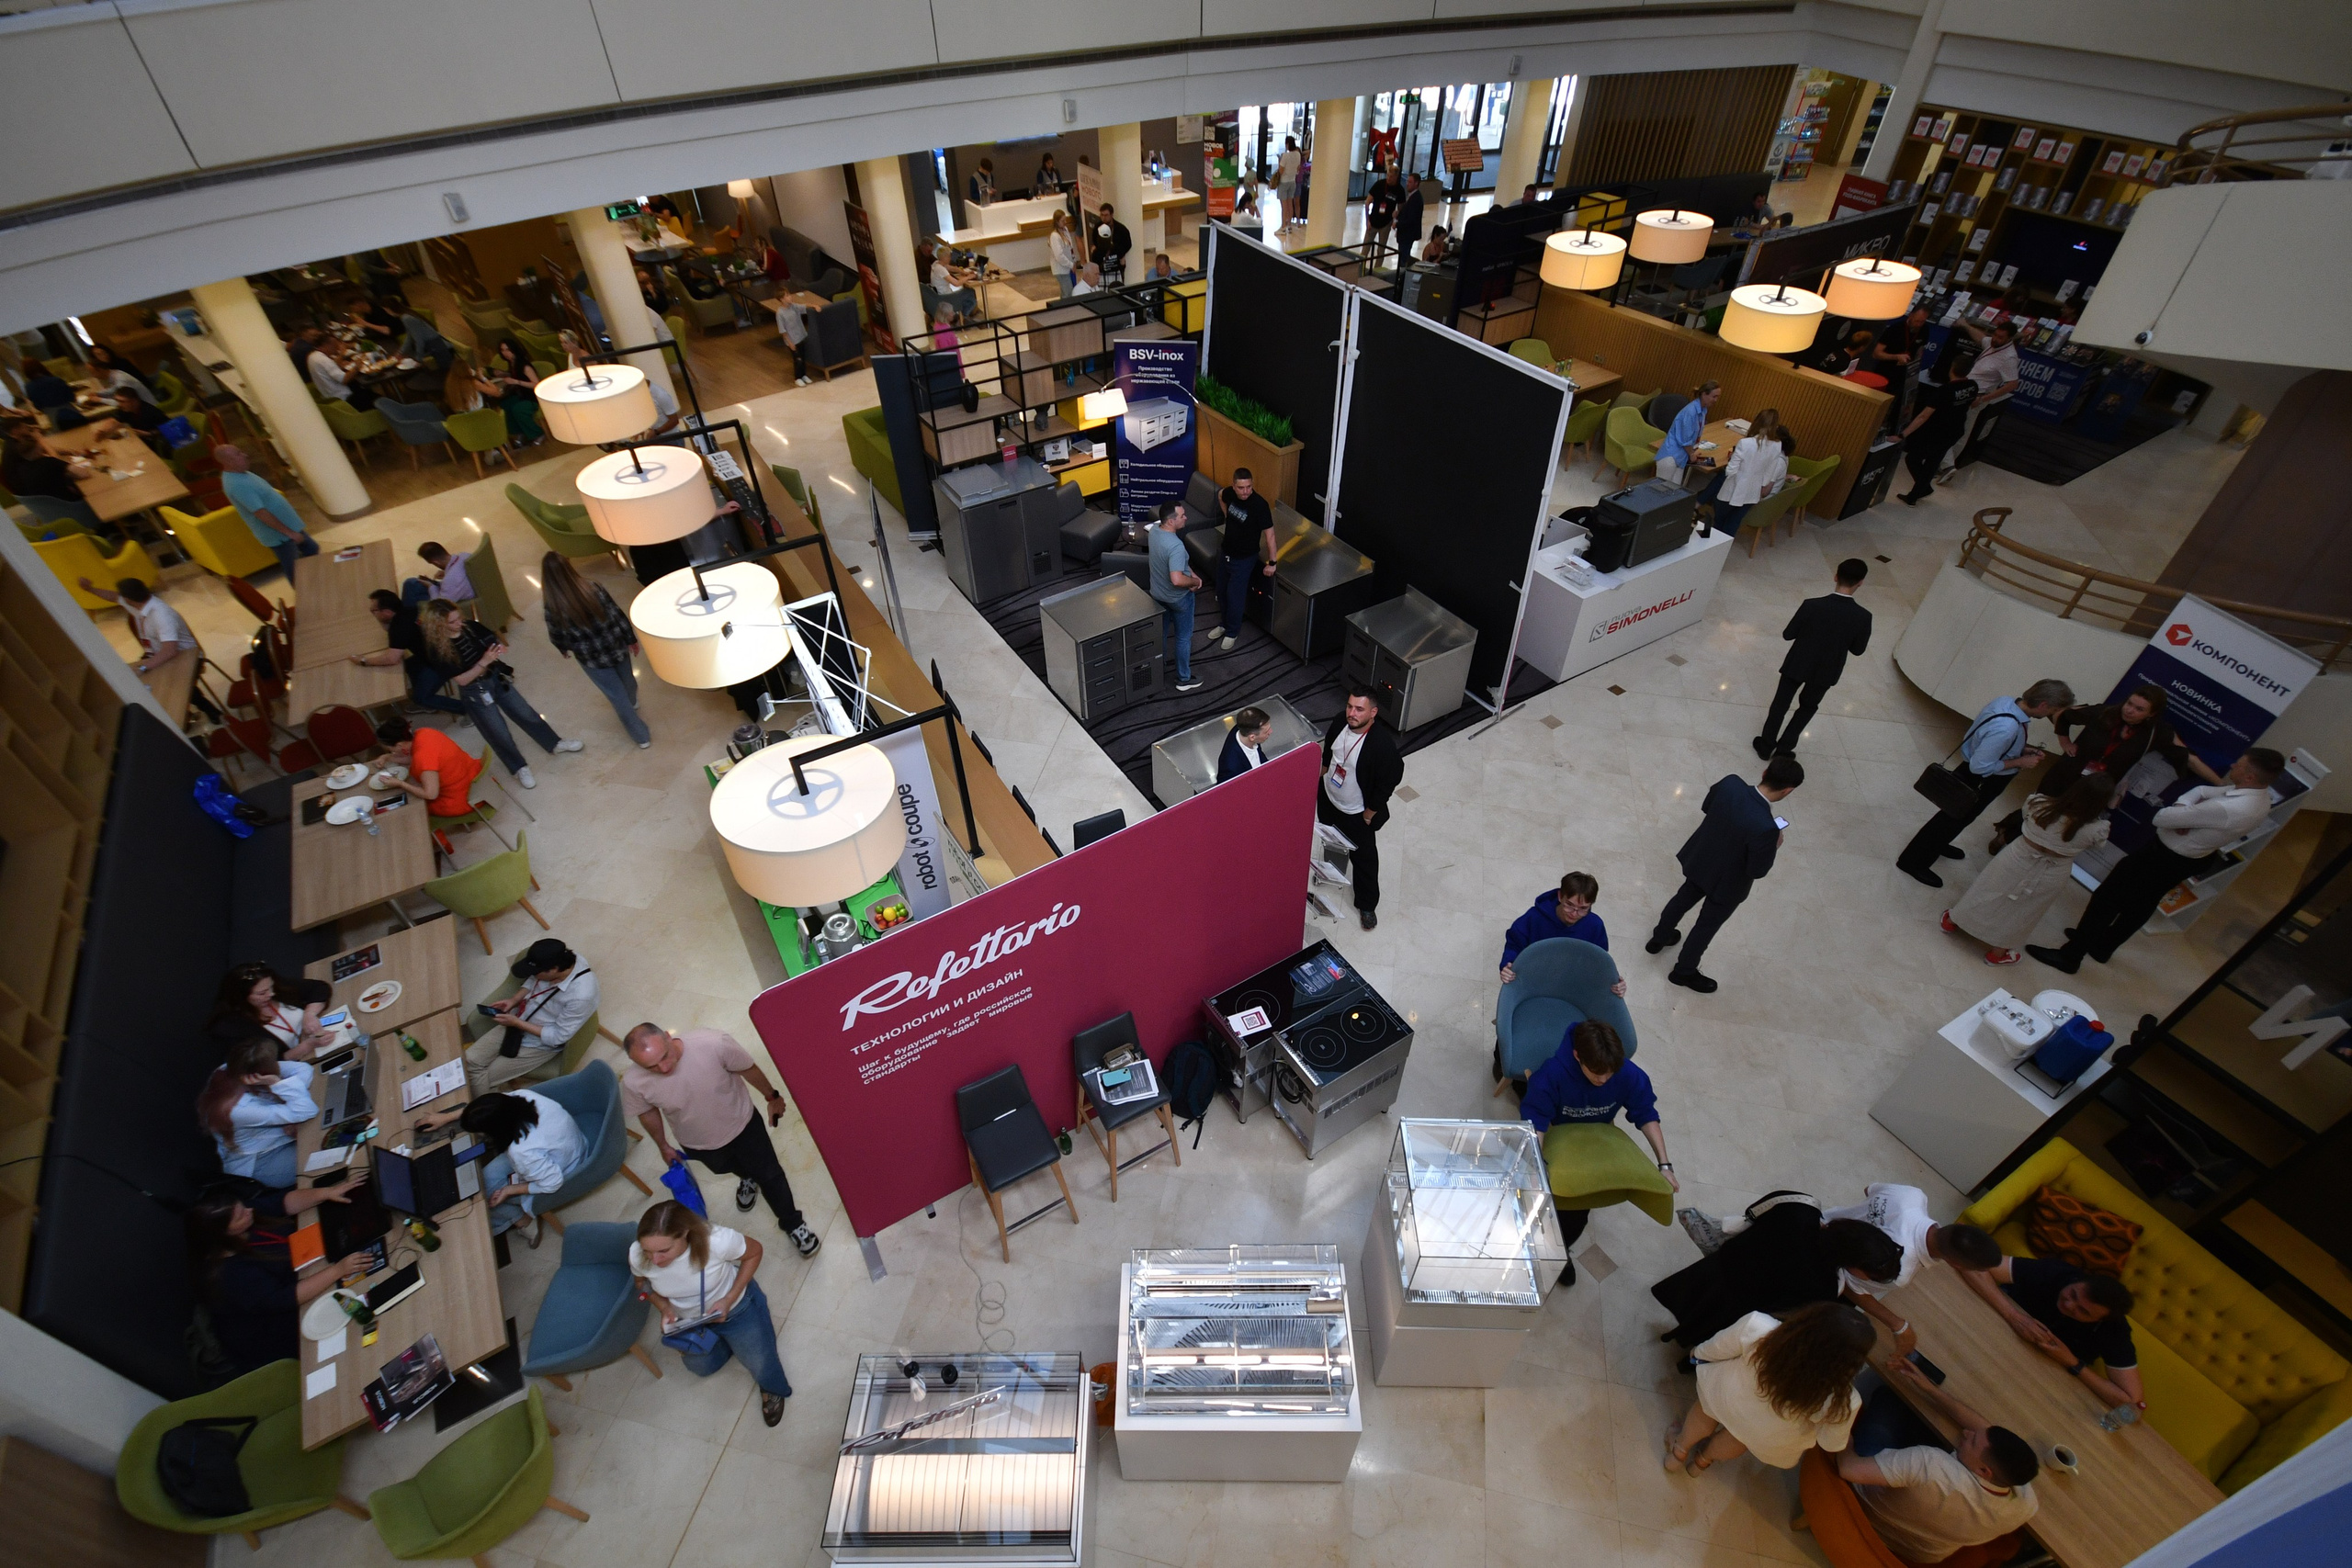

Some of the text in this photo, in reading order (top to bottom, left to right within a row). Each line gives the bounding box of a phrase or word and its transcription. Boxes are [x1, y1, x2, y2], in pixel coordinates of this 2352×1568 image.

[1843, 234, 1892, 259] МИКРО
[1129, 348, 1184, 361] BSV-inox
[2018, 359, 2056, 383] НЯЕМ
[2014, 378, 2046, 399] ОРОВ
[1606, 589, 1694, 635] SIMONELLI
[1611, 606, 1642, 622] nuova
[2191, 638, 2291, 697] КОМПОНЕНТ
[2170, 679, 2222, 715] НОВИНКА
[897, 784, 937, 890] robot coupe
[840, 902, 1081, 1032] Refettorio
[850, 968, 1024, 1055] ТЕХНОЛОГИИ И ДИЗАЙН
[858, 1057, 880, 1073] Шаг
[894, 1026, 951, 1055] будущему,
[953, 1015, 971, 1029] где
[973, 987, 1033, 1019] российское
[861, 992, 1033, 1079] оборудование задает мировые
[863, 1054, 922, 1086] стандарты
[840, 1393, 1001, 1456] Refettorio
